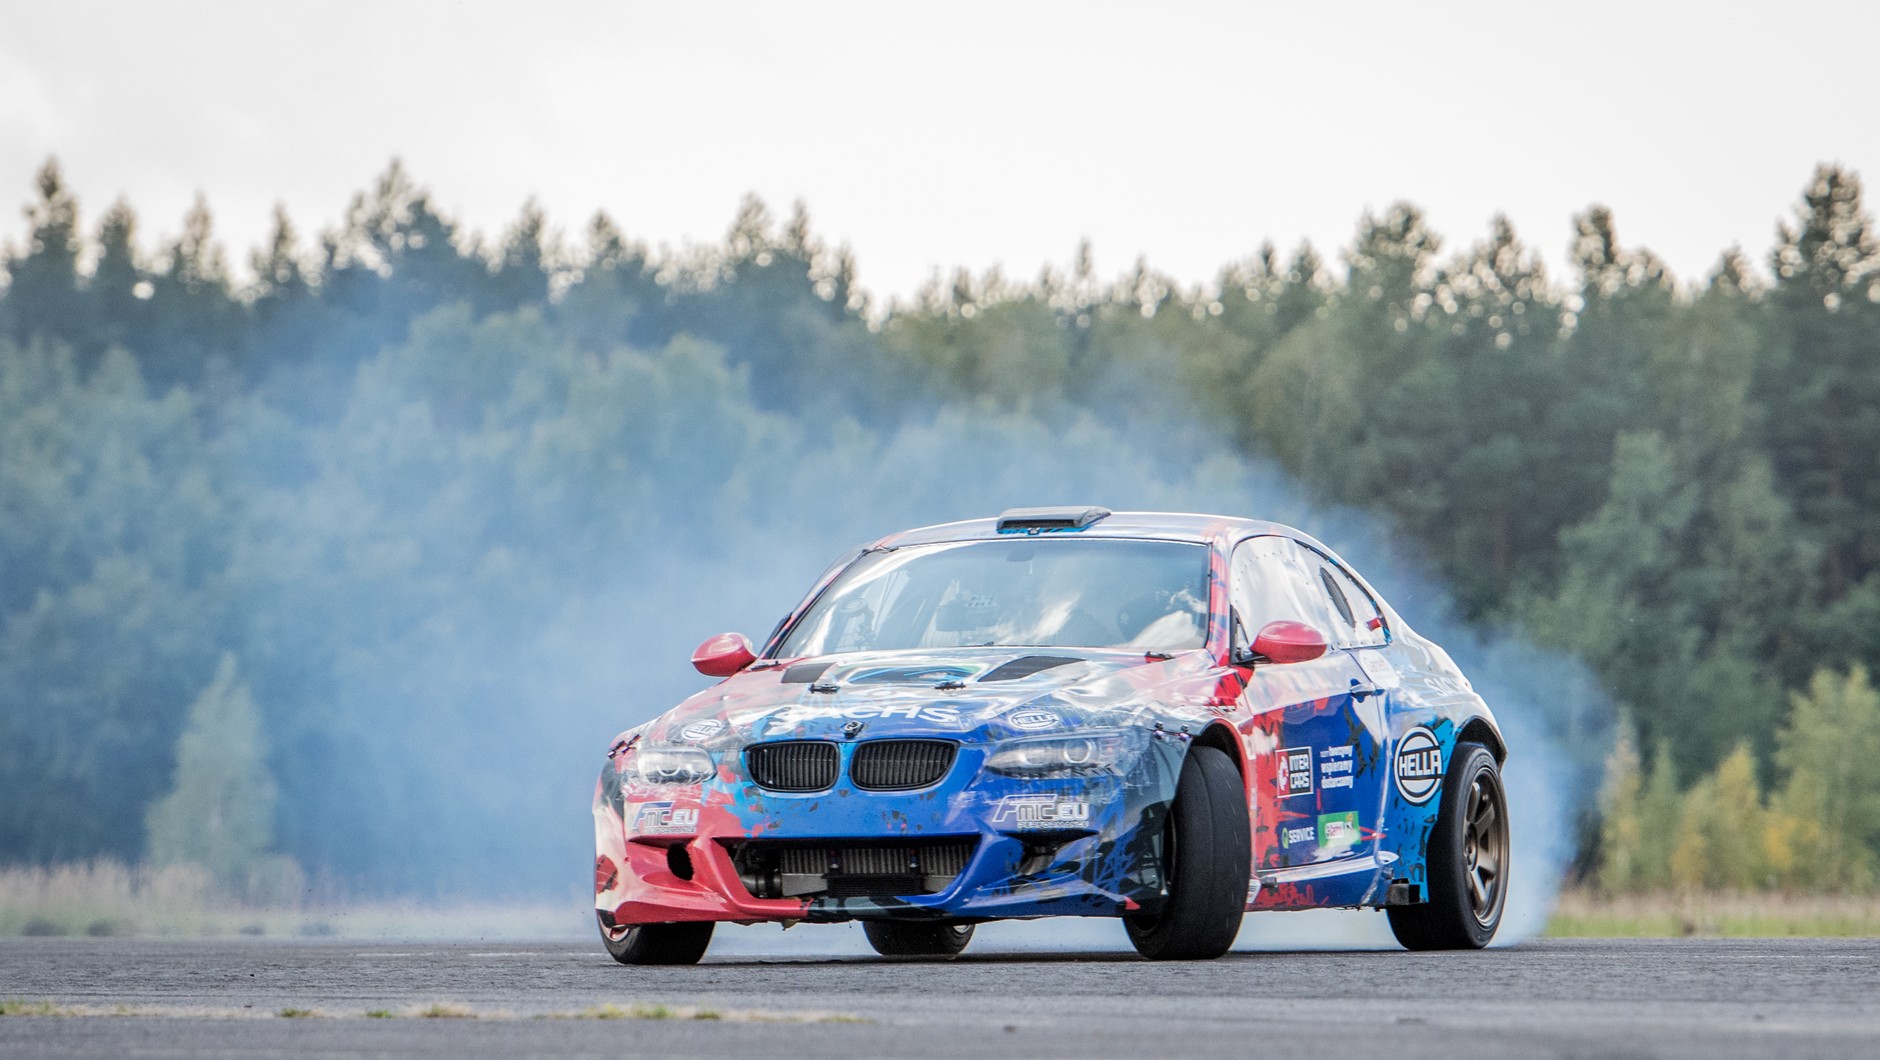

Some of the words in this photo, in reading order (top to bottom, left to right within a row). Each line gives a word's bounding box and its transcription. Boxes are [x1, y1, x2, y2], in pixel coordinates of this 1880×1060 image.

[1289, 754, 1309, 771] INTER
[1399, 749, 1442, 777] HELLA
[1289, 771, 1310, 789] CARS
[1288, 826, 1315, 844] SERVICE
